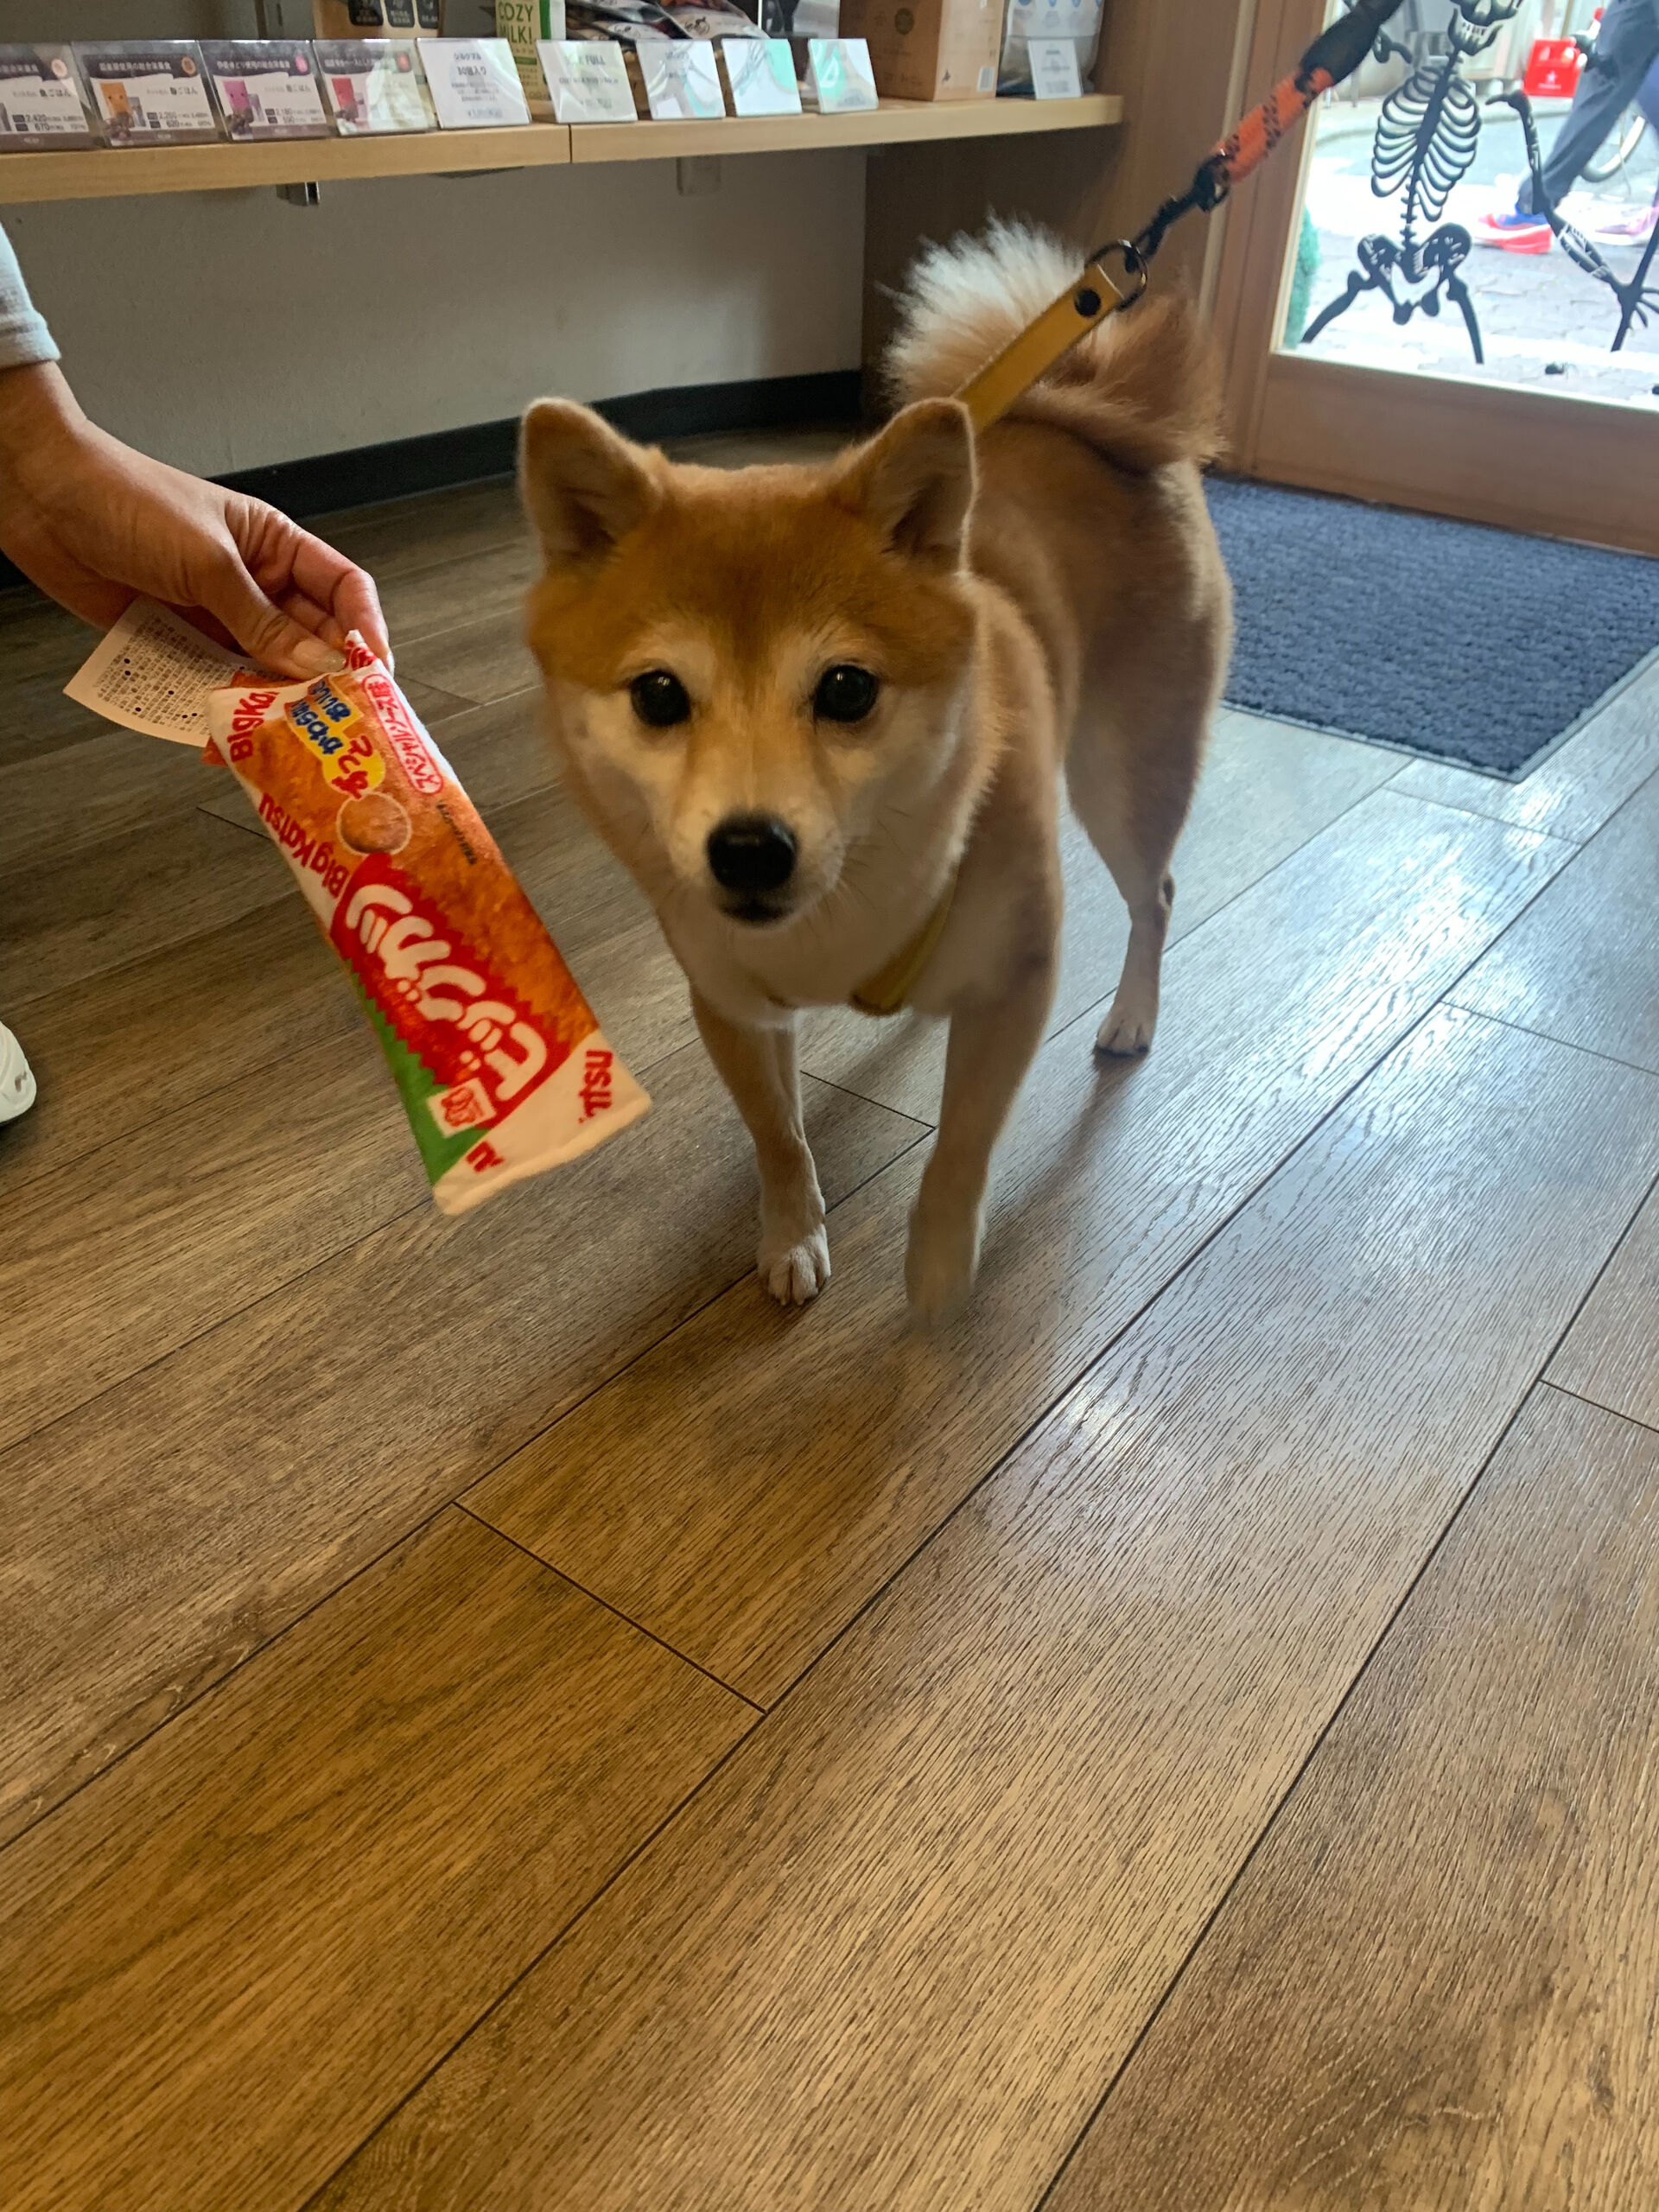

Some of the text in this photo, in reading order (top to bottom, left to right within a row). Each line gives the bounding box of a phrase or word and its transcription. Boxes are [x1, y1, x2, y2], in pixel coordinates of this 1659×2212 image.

[498, 2, 533, 22] COZY
[226, 691, 280, 763] BigKa
[346, 884, 547, 1101] ビッグカツ
